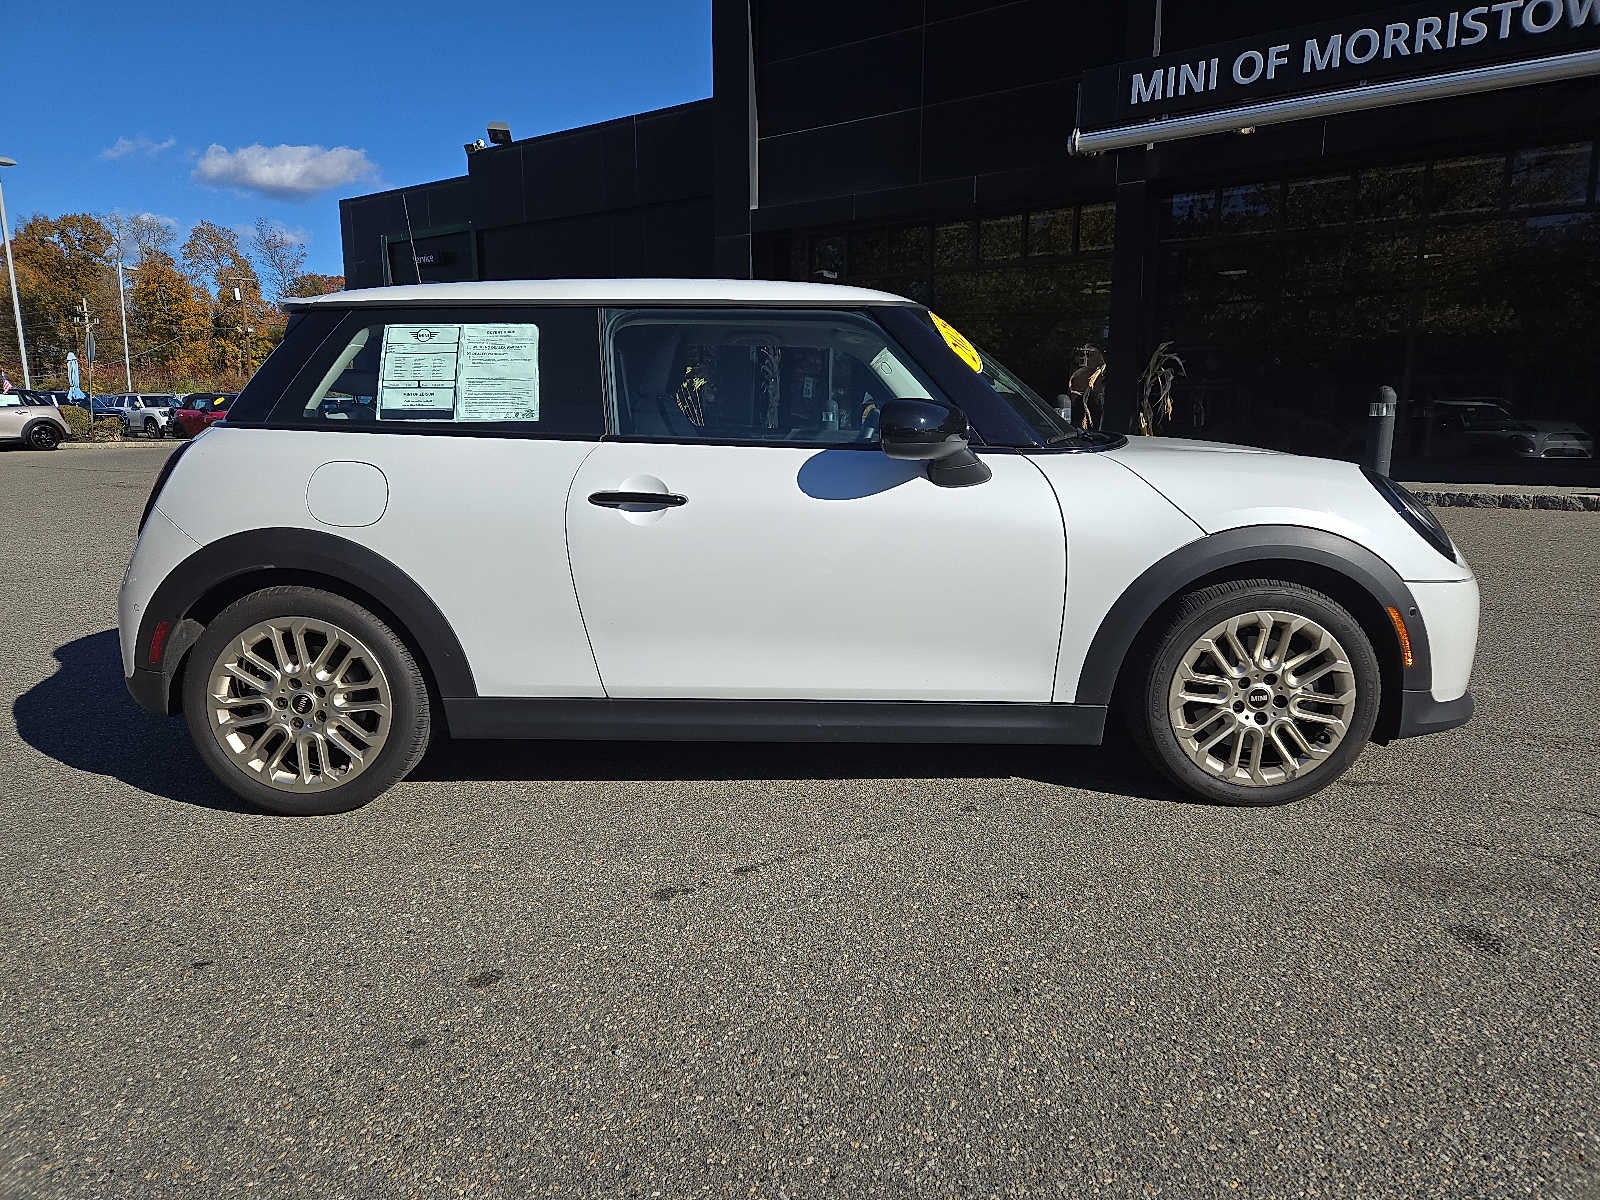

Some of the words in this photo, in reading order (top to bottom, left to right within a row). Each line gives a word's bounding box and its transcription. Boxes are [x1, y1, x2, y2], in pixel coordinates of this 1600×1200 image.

[1130, 58, 1218, 105] MINI
[1232, 43, 1290, 85] OF
[1250, 694, 1268, 702] MINI
